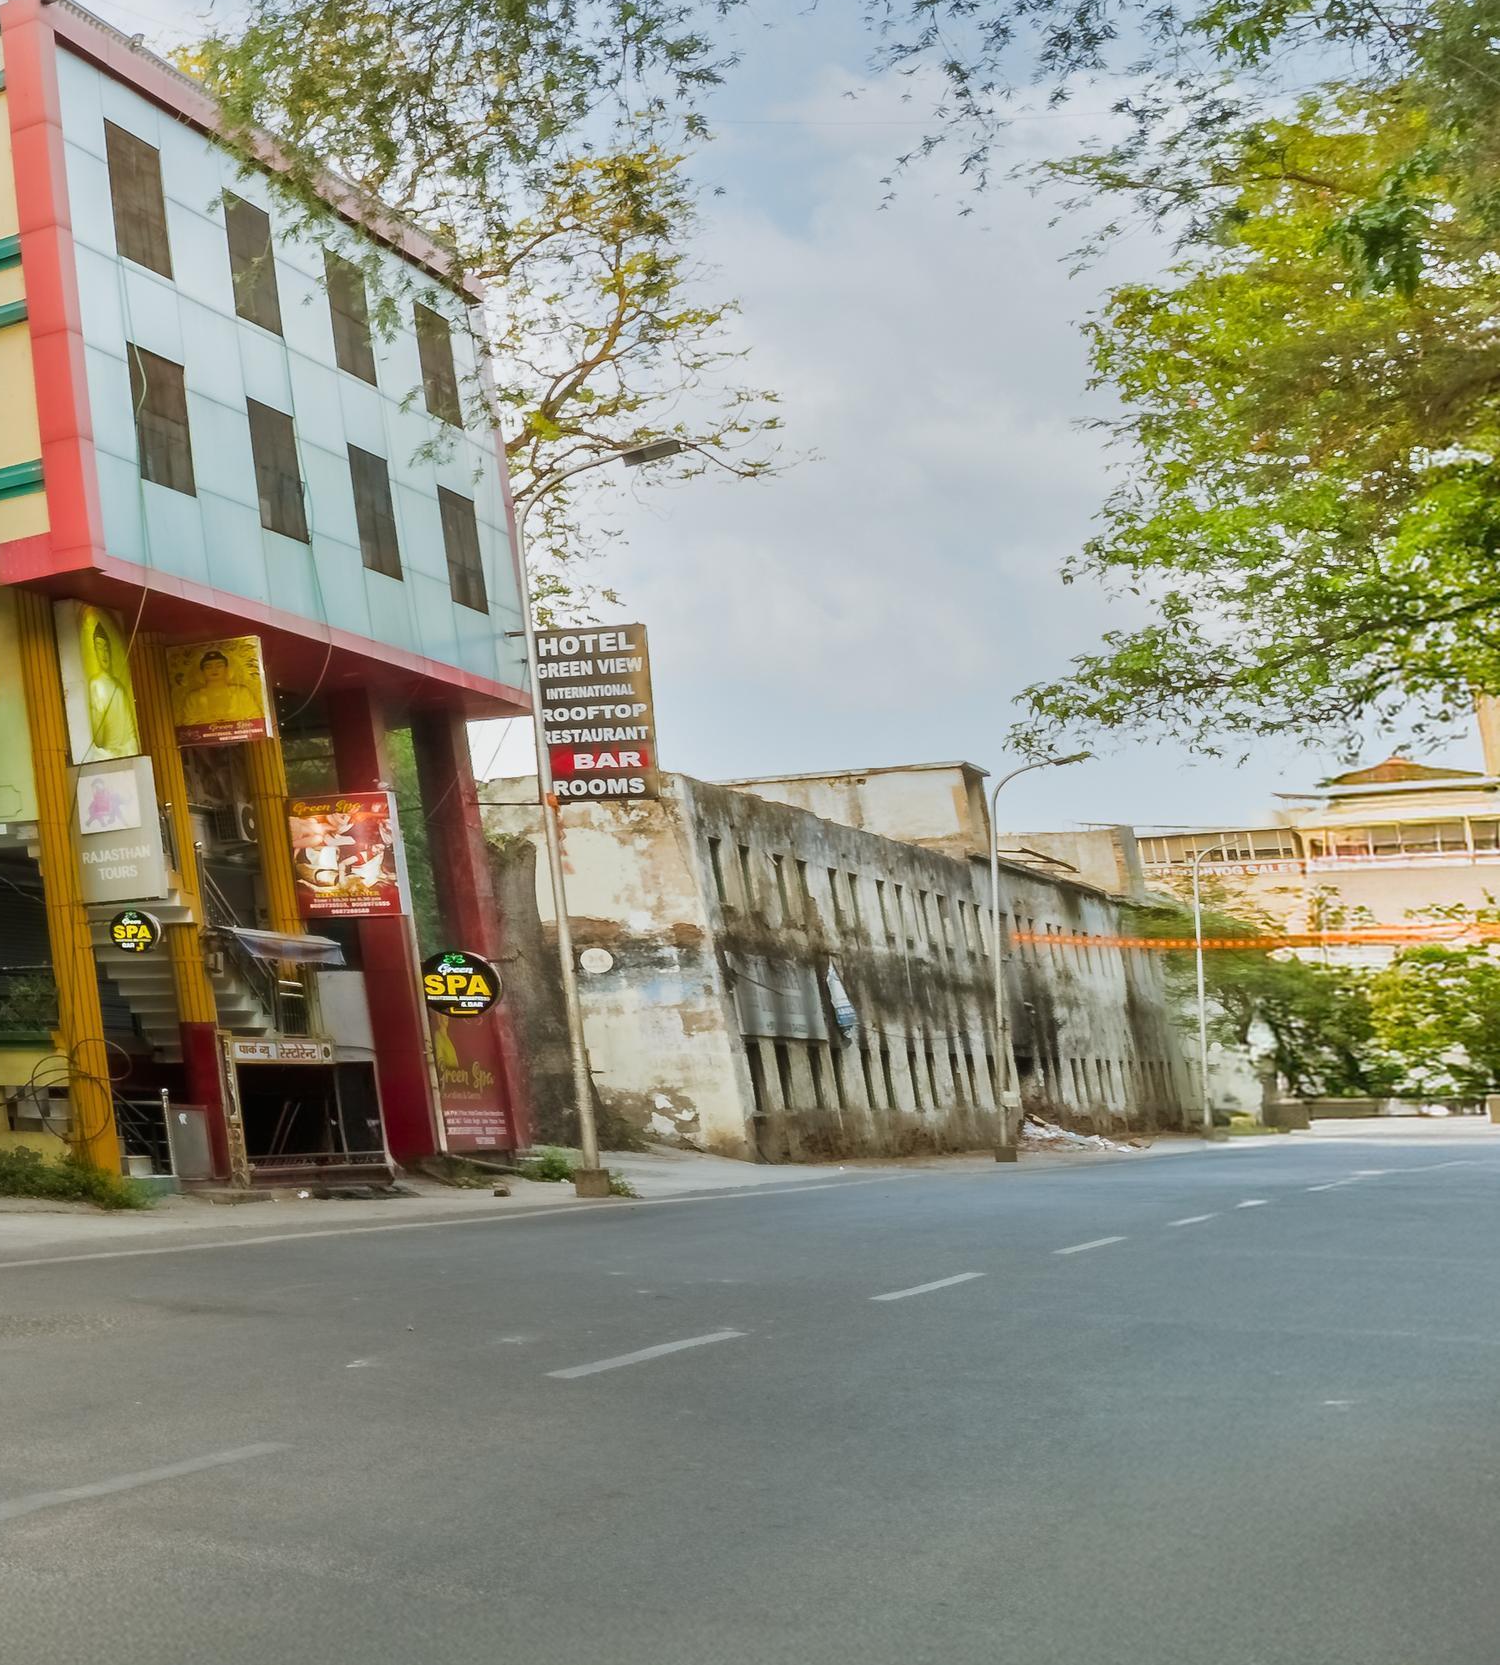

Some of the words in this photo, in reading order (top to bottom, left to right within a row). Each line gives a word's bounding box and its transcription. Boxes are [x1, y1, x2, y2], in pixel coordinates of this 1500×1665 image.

[538, 631, 636, 657] HOTEL
[536, 660, 593, 679] GREEN
[597, 657, 643, 675] VIEW
[546, 683, 636, 700] INTERNATIONAL
[542, 703, 647, 722] ROOFTOP
[573, 751, 642, 770] BAR
[552, 777, 646, 797] ROOMS
[292, 801, 331, 815] Green
[334, 799, 362, 814] Spa
[82, 844, 151, 865] RAJASTHAN
[97, 865, 138, 881] TOURS
[113, 924, 152, 939] SPA
[437, 963, 473, 976] Green
[424, 974, 492, 996] SPA
